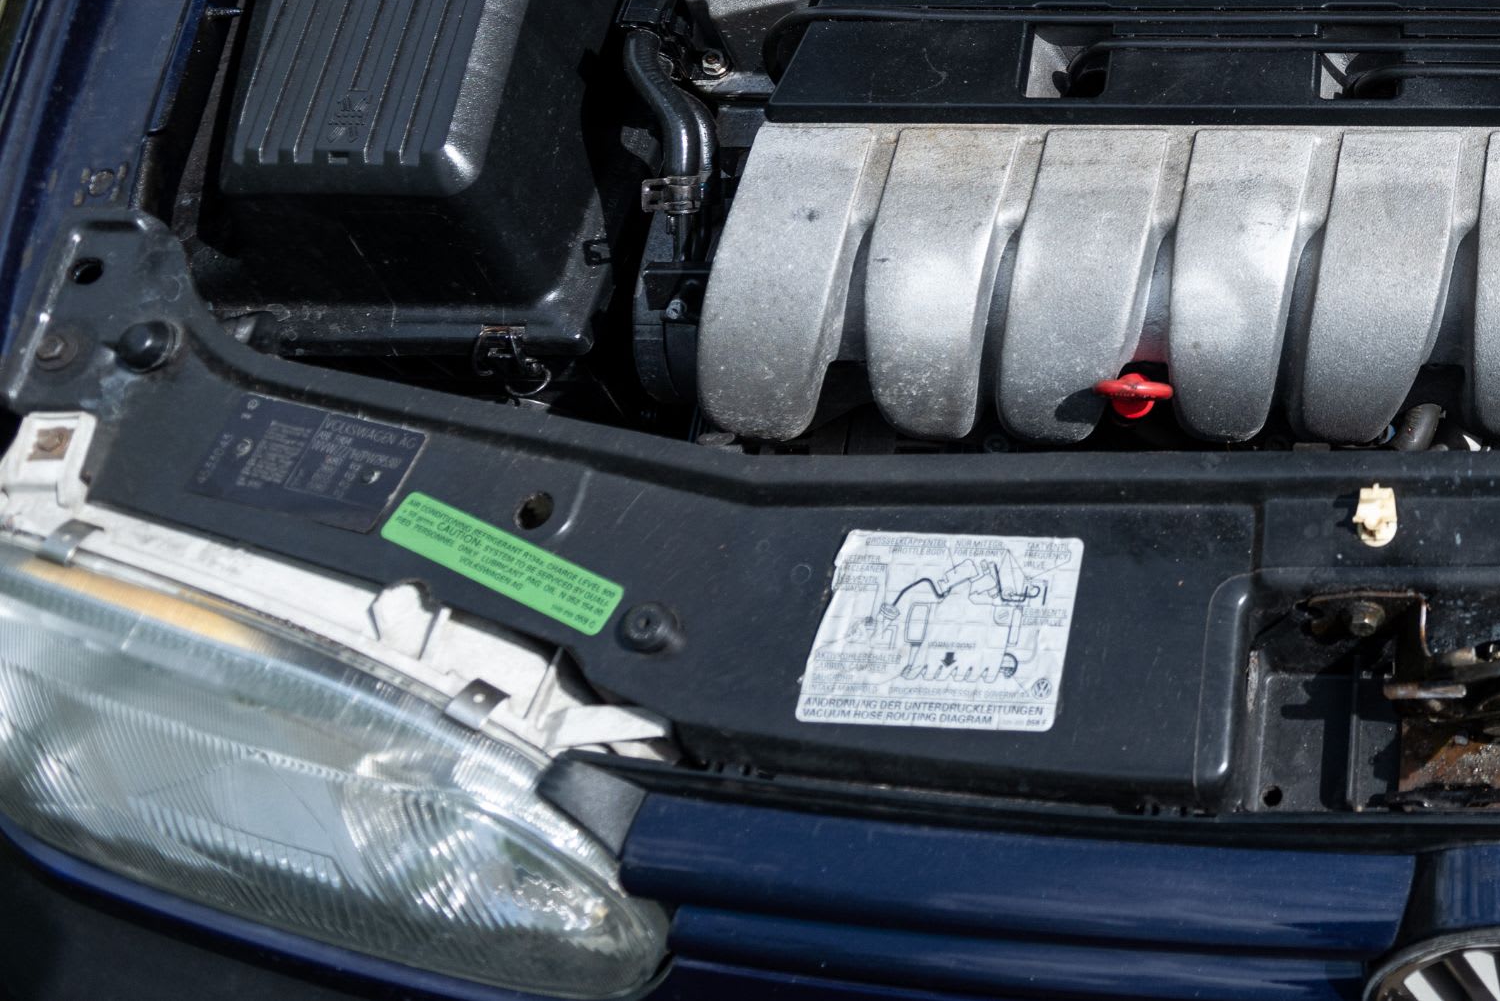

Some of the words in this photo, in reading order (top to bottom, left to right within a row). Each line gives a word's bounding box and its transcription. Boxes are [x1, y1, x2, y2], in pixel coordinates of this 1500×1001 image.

[324, 417, 396, 445] VOLKSWAGEN
[458, 544, 479, 557] ONLY
[471, 529, 522, 554] REFRIGERANT
[547, 563, 578, 581] CHARGE
[578, 577, 600, 592] LEVEL
[459, 557, 511, 584] VOLKSWAGEN
[510, 581, 524, 591] AG
[483, 545, 515, 563] SYSTEM
[515, 559, 526, 569] TO
[525, 564, 537, 574] BE
[536, 569, 573, 590] SERVICED
[572, 586, 585, 594] BY
[801, 708, 851, 719] VACUUM
[852, 710, 883, 719] HOSE
[885, 711, 936, 721] ROUTING
[938, 713, 993, 724] DIAGRAM
[803, 696, 878, 709] ANORDNUNG
[879, 700, 902, 709] DER
[903, 700, 1043, 716] UNTERDRUCKLEITUNGEN
